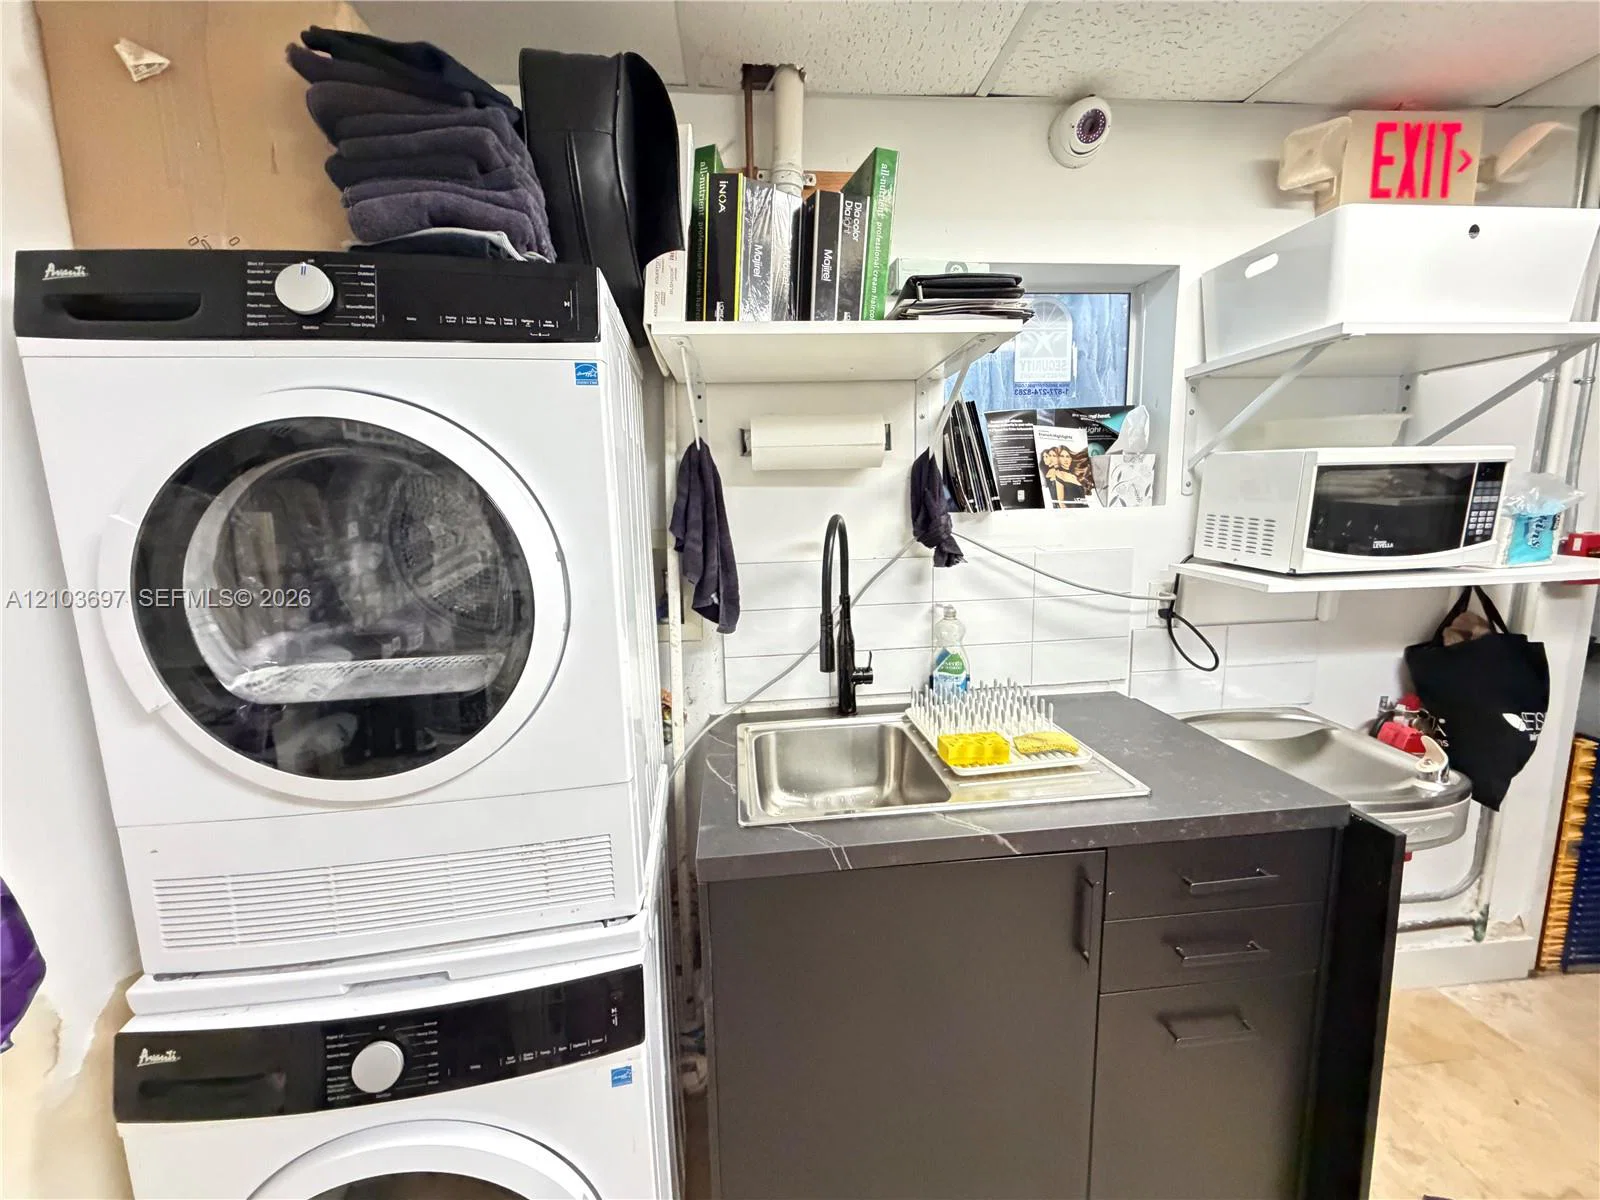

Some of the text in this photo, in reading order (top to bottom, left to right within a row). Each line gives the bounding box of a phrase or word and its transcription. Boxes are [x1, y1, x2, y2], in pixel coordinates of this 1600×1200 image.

[1370, 121, 1463, 199] EXIT
[877, 162, 890, 219] all-nutrient
[753, 244, 764, 278] Majirel
[873, 221, 883, 268] professional
[42, 262, 88, 280] Avanti
[821, 249, 833, 282] Majirel
[871, 269, 881, 294] cream
[137, 1048, 181, 1067] Avanti
